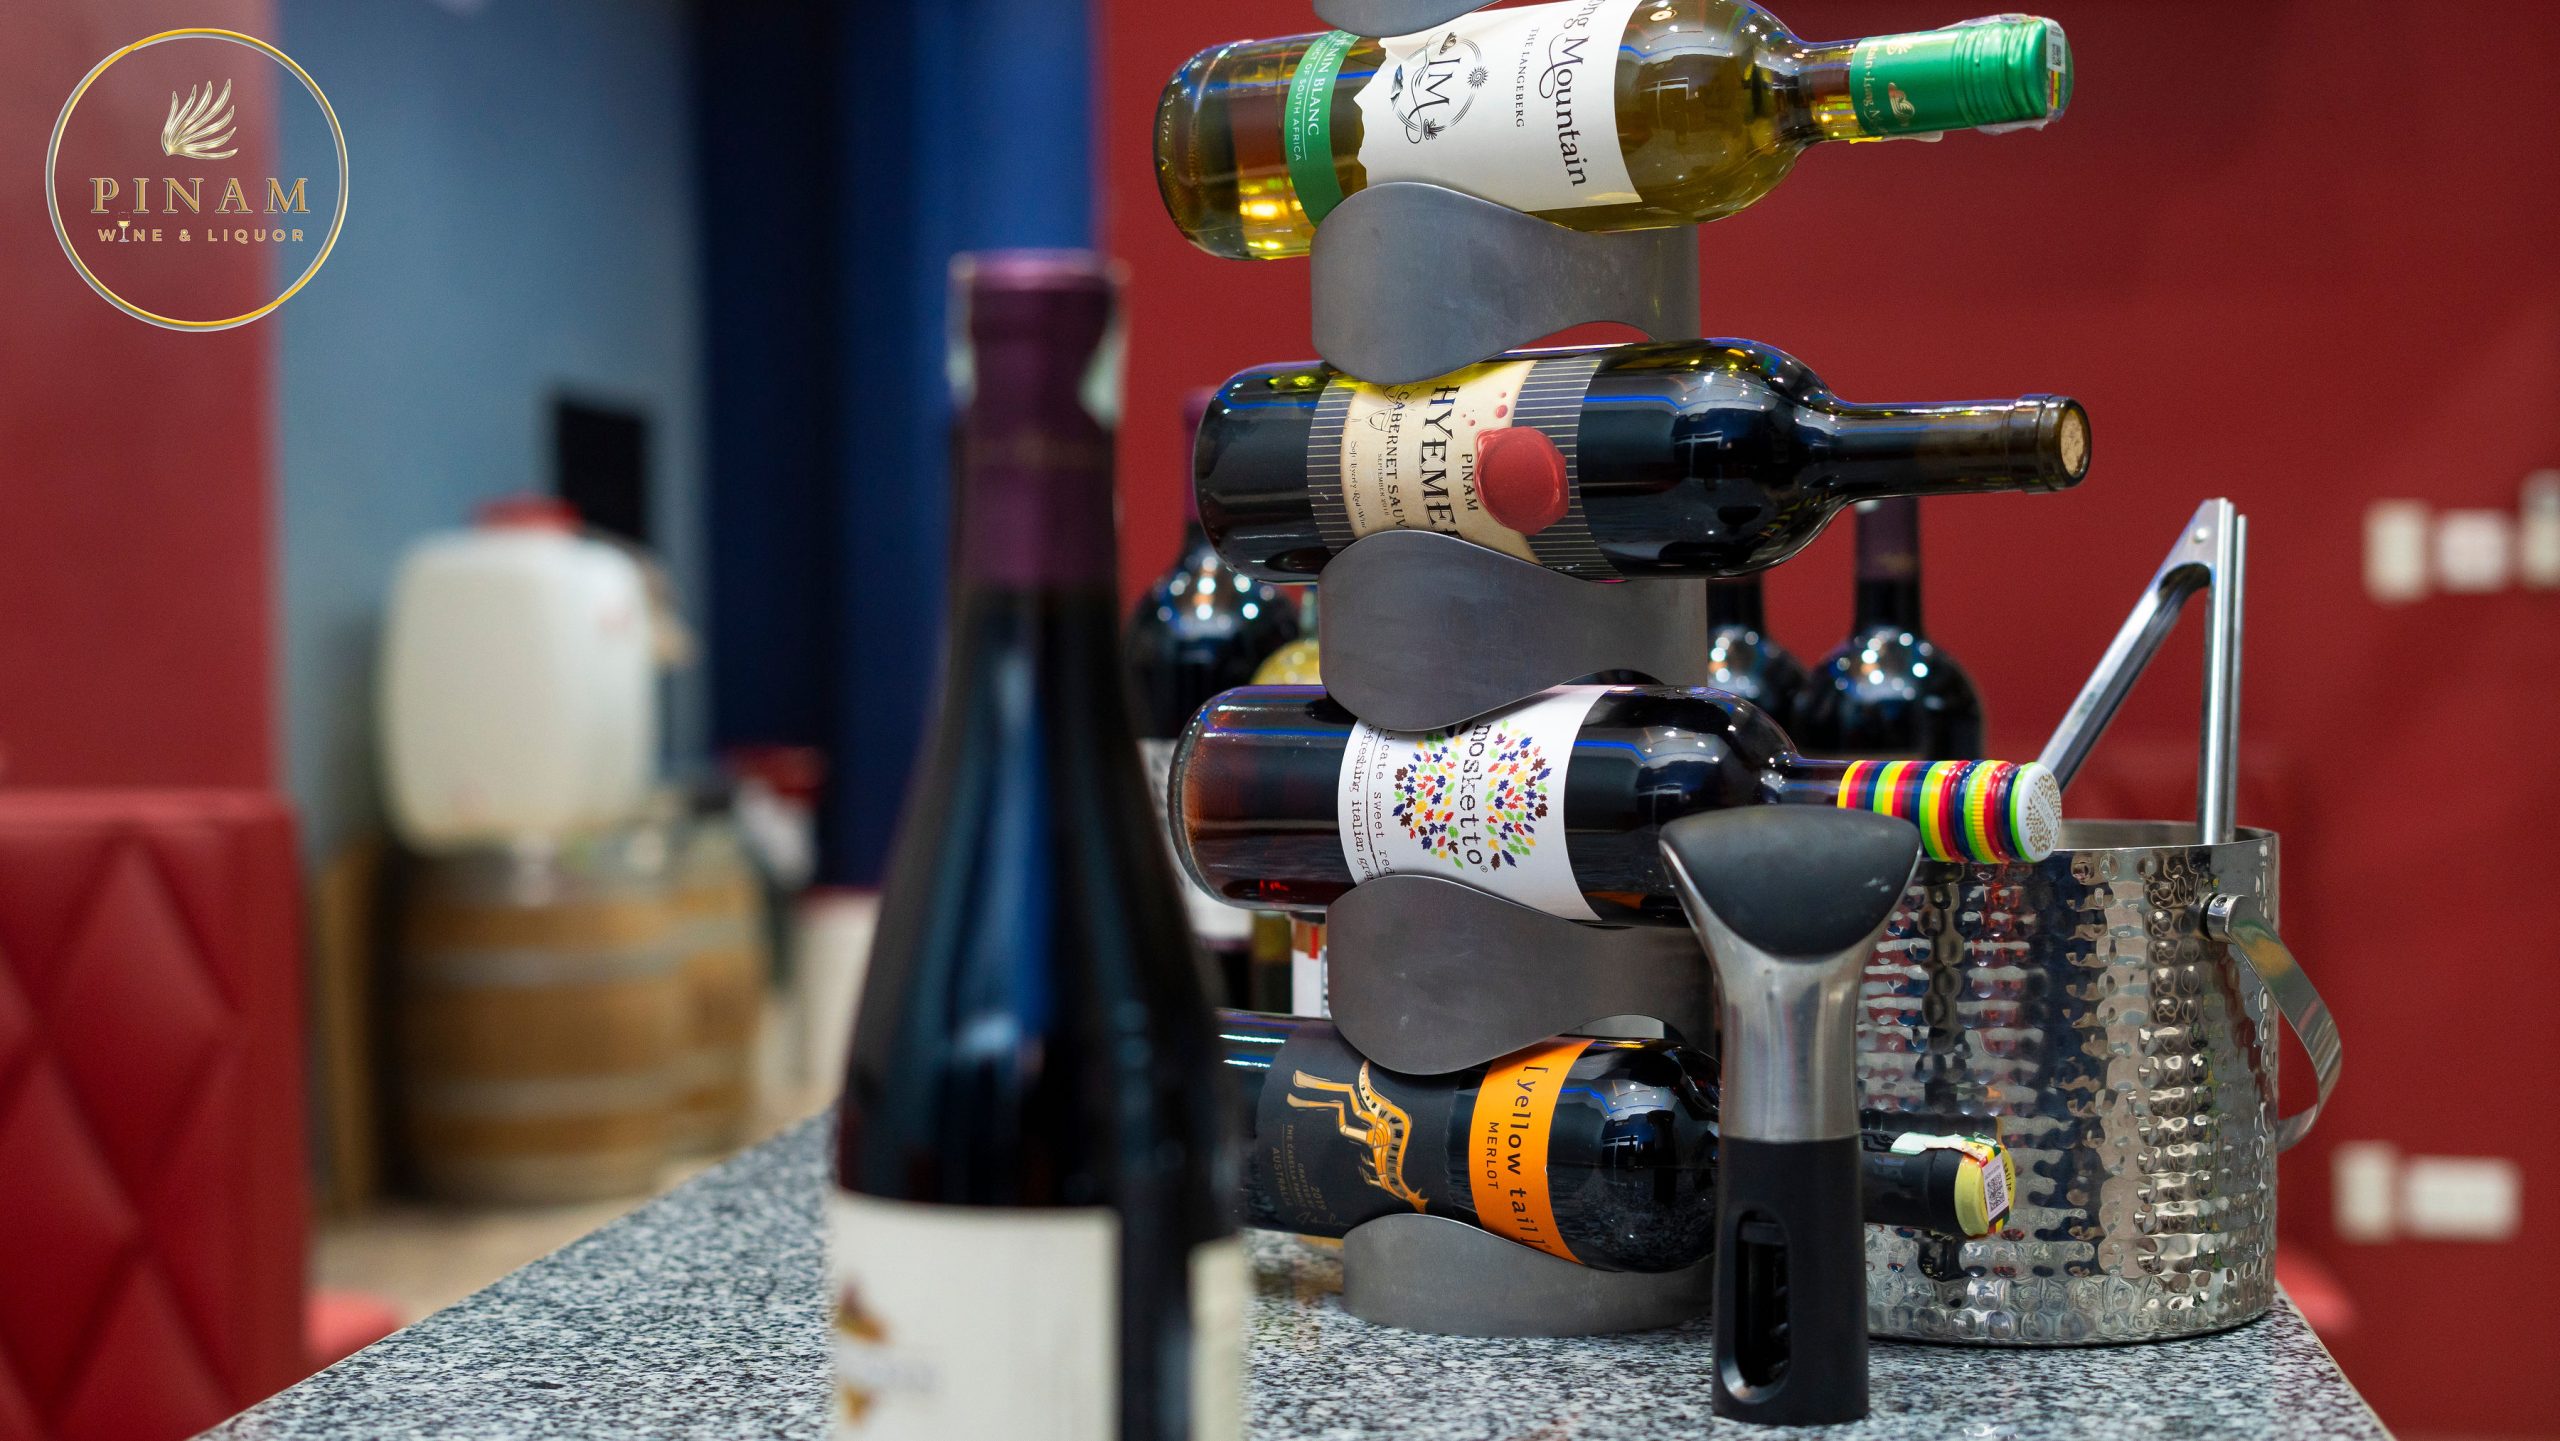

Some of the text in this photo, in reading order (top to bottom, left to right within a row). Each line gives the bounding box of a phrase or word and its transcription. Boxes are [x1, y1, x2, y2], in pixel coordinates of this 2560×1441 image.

[1294, 78, 1305, 113] SOUTH
[1303, 63, 1313, 76] OF
[1515, 27, 1540, 128] THE LANGEBERG
[1307, 77, 1326, 136] BLANC
[1539, 33, 1590, 187] Mountain
[1291, 118, 1302, 162] AFRICA
[1385, 391, 1410, 479] CABERNET
[1461, 453, 1479, 511] PINAM
[1352, 799, 1365, 853] italian
[1459, 724, 1492, 865] mosketto
[1373, 791, 1385, 838] sweet
[1379, 850, 1395, 875] red
[1486, 1121, 1500, 1190] MERLOT
